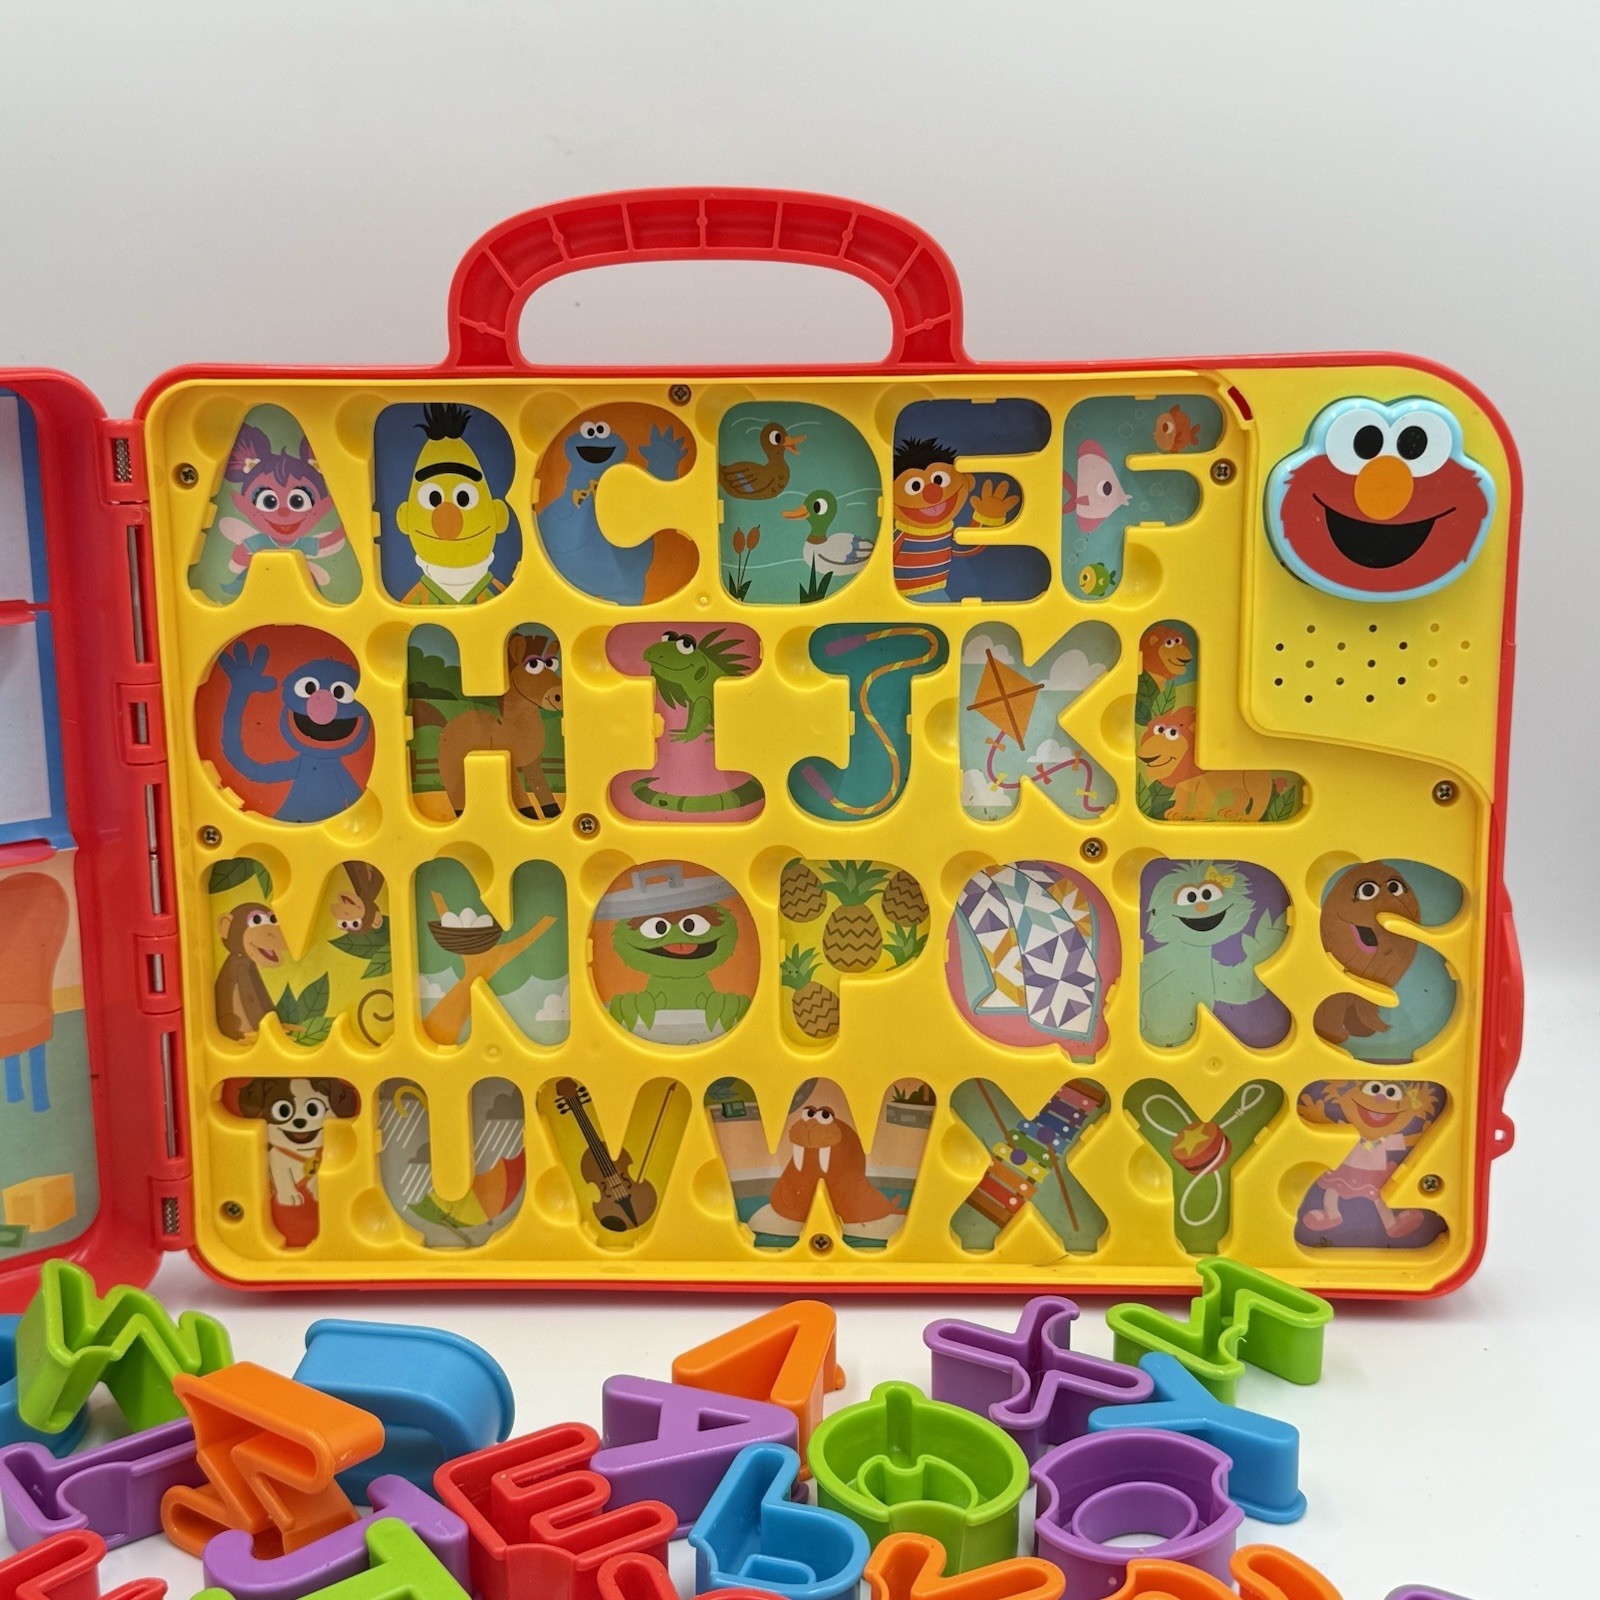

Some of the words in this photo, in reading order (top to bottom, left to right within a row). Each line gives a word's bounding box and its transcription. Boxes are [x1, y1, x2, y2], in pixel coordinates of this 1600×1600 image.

[187, 404, 362, 605] A
[372, 401, 523, 606] B
[532, 401, 698, 605] C
[717, 401, 881, 605] D
[893, 398, 1051, 602] E
[1062, 395, 1224, 601] F
[407, 622, 567, 820] H
[606, 622, 765, 821] I
[788, 622, 949, 821] J
[960, 621, 1121, 822] K
[1135, 619, 1305, 822] L
[208, 857, 394, 1045] M
[415, 857, 570, 1046] N
[589, 859, 761, 1045] O
[779, 859, 930, 1043] P
[945, 860, 1121, 1063] Q
[1139, 859, 1293, 1048] R
[1313, 859, 1464, 1063] S
[222, 1077, 360, 1248] T
[376, 1077, 526, 1248] U
[536, 1077, 692, 1248] V
[704, 1077, 937, 1248] W
[949, 1078, 1110, 1251] X
[1123, 1078, 1285, 1252] Y
[1295, 1081, 1448, 1248] Z
[924, 1297, 1154, 1428] X
